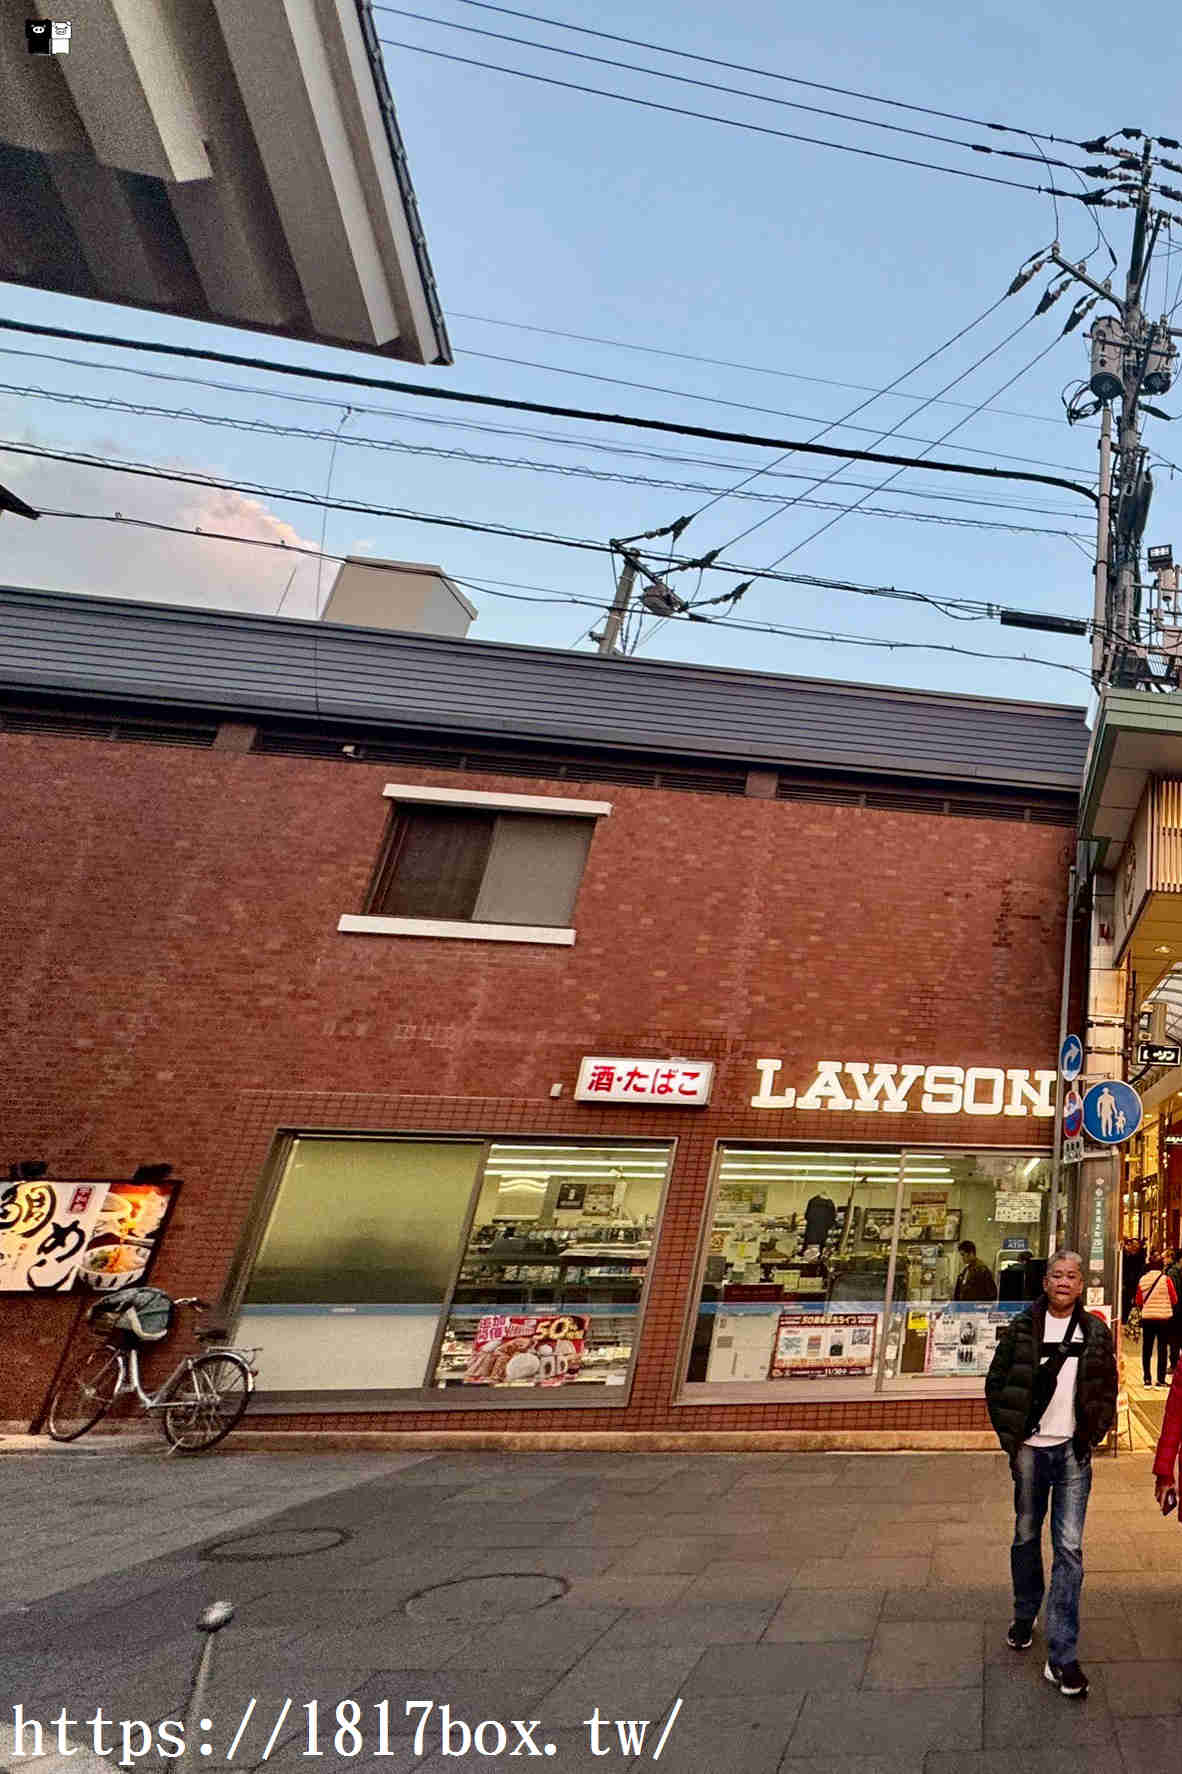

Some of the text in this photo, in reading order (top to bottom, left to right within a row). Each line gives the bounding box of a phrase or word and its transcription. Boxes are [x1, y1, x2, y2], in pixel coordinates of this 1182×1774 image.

[587, 1064, 700, 1096] 酒・たばこ
[750, 1059, 1056, 1118] LAWSON
